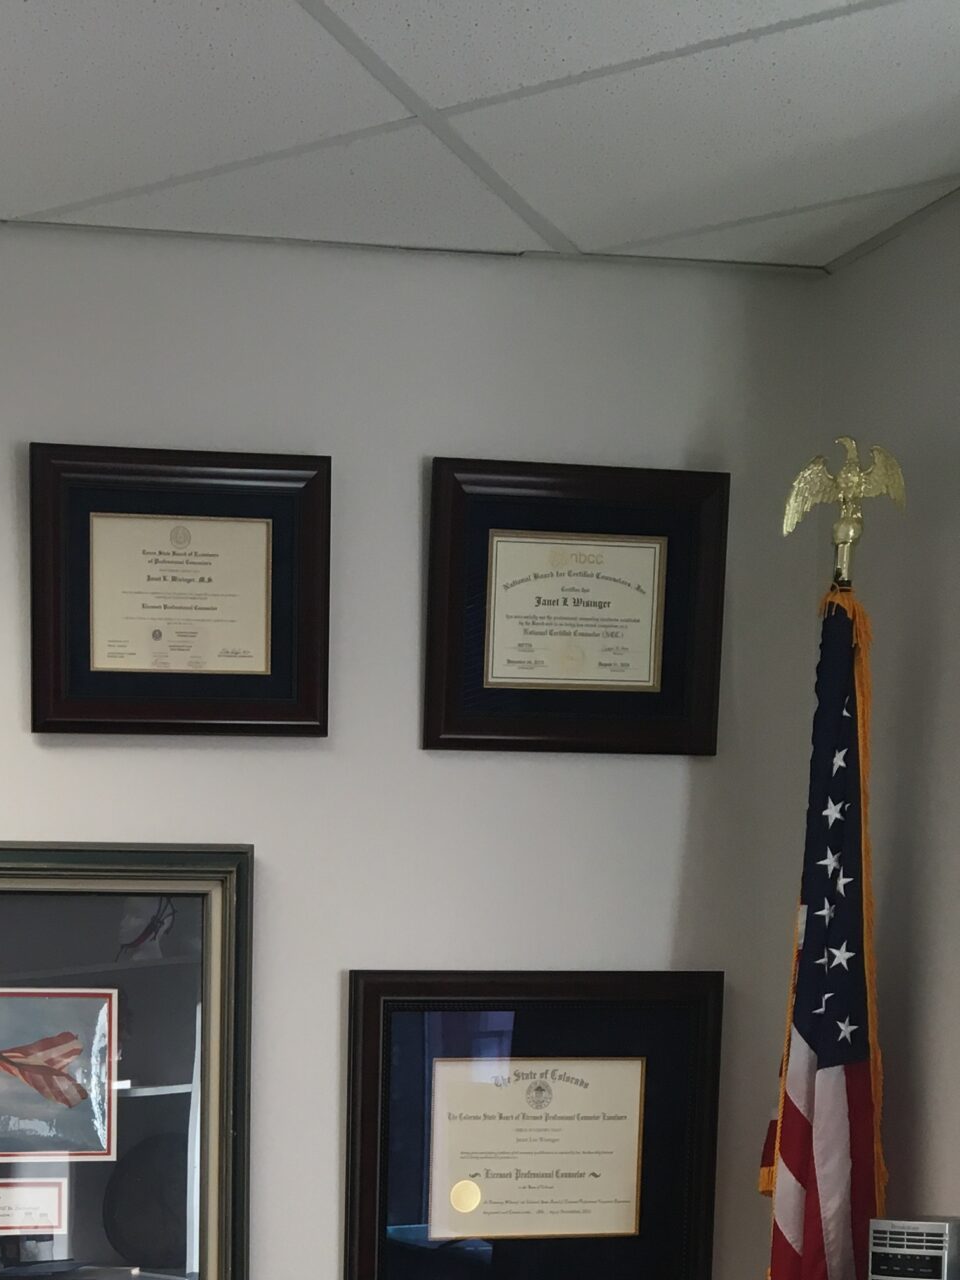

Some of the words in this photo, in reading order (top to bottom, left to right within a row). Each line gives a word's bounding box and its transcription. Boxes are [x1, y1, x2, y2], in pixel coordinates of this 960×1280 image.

[570, 552, 604, 565] nbcc
[535, 596, 559, 607] Janet
[572, 597, 611, 610] Wisinger
[513, 1069, 537, 1082] State
[539, 1069, 549, 1079] of
[550, 1069, 590, 1089] Colorado
